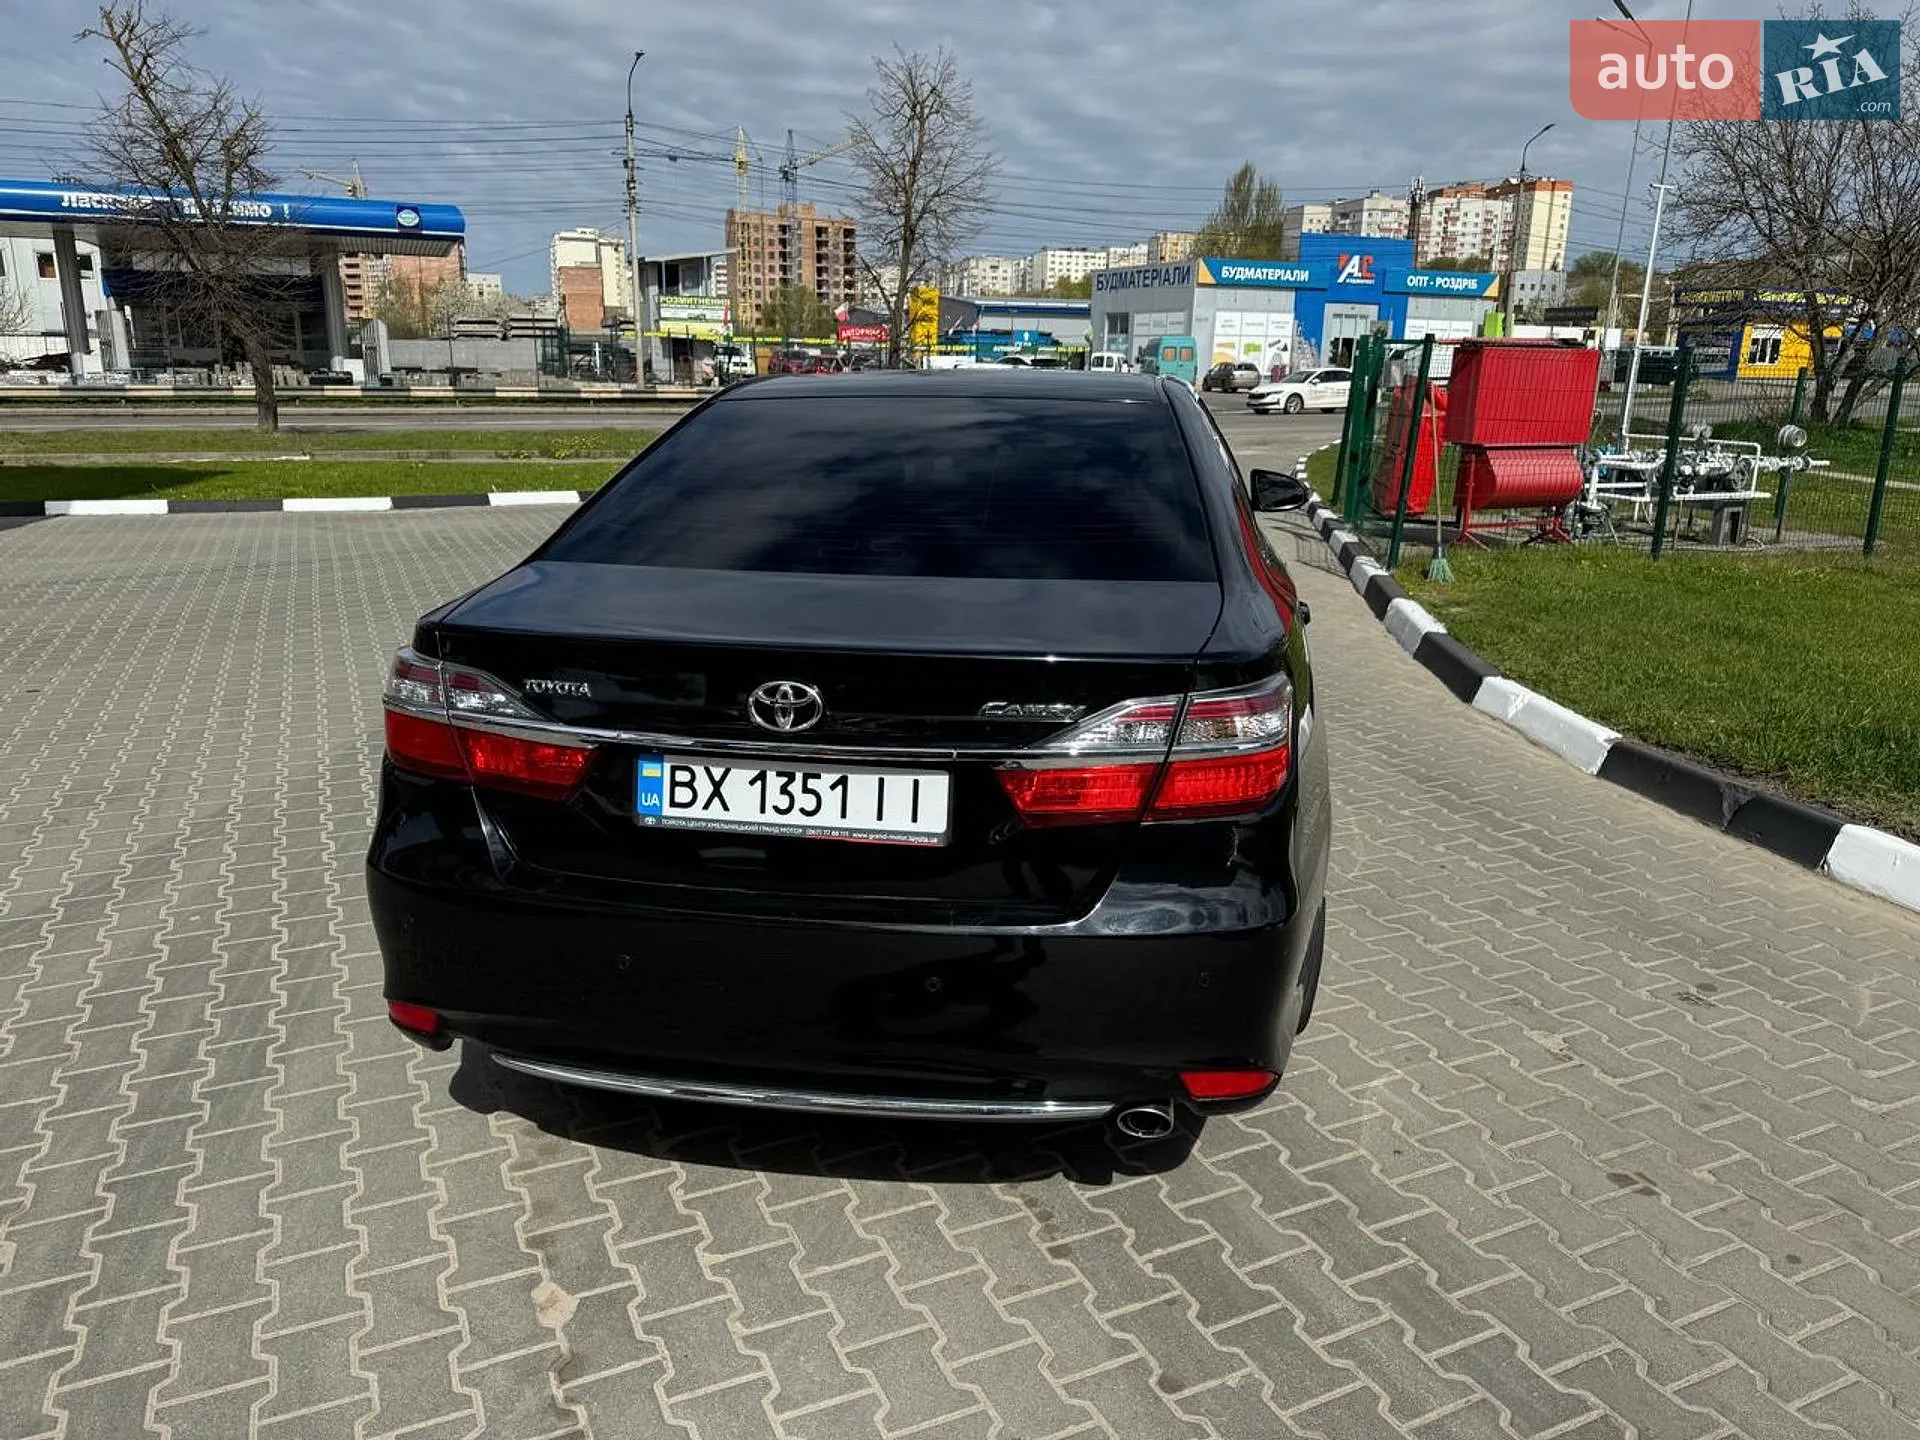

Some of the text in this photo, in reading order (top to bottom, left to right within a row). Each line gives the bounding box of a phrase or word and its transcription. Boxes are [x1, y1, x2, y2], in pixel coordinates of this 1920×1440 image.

[1096, 265, 1191, 293] БУДМАТЕРІАЛИ
[1221, 265, 1309, 282] БУДМАТЕРІАЛИ
[1407, 275, 1427, 288] ОПТ
[1436, 279, 1477, 291] РОЗДРІБ
[523, 679, 591, 698] TOYOTA
[641, 794, 660, 807] UA
[669, 765, 731, 811] BX
[749, 770, 848, 819] 1351
